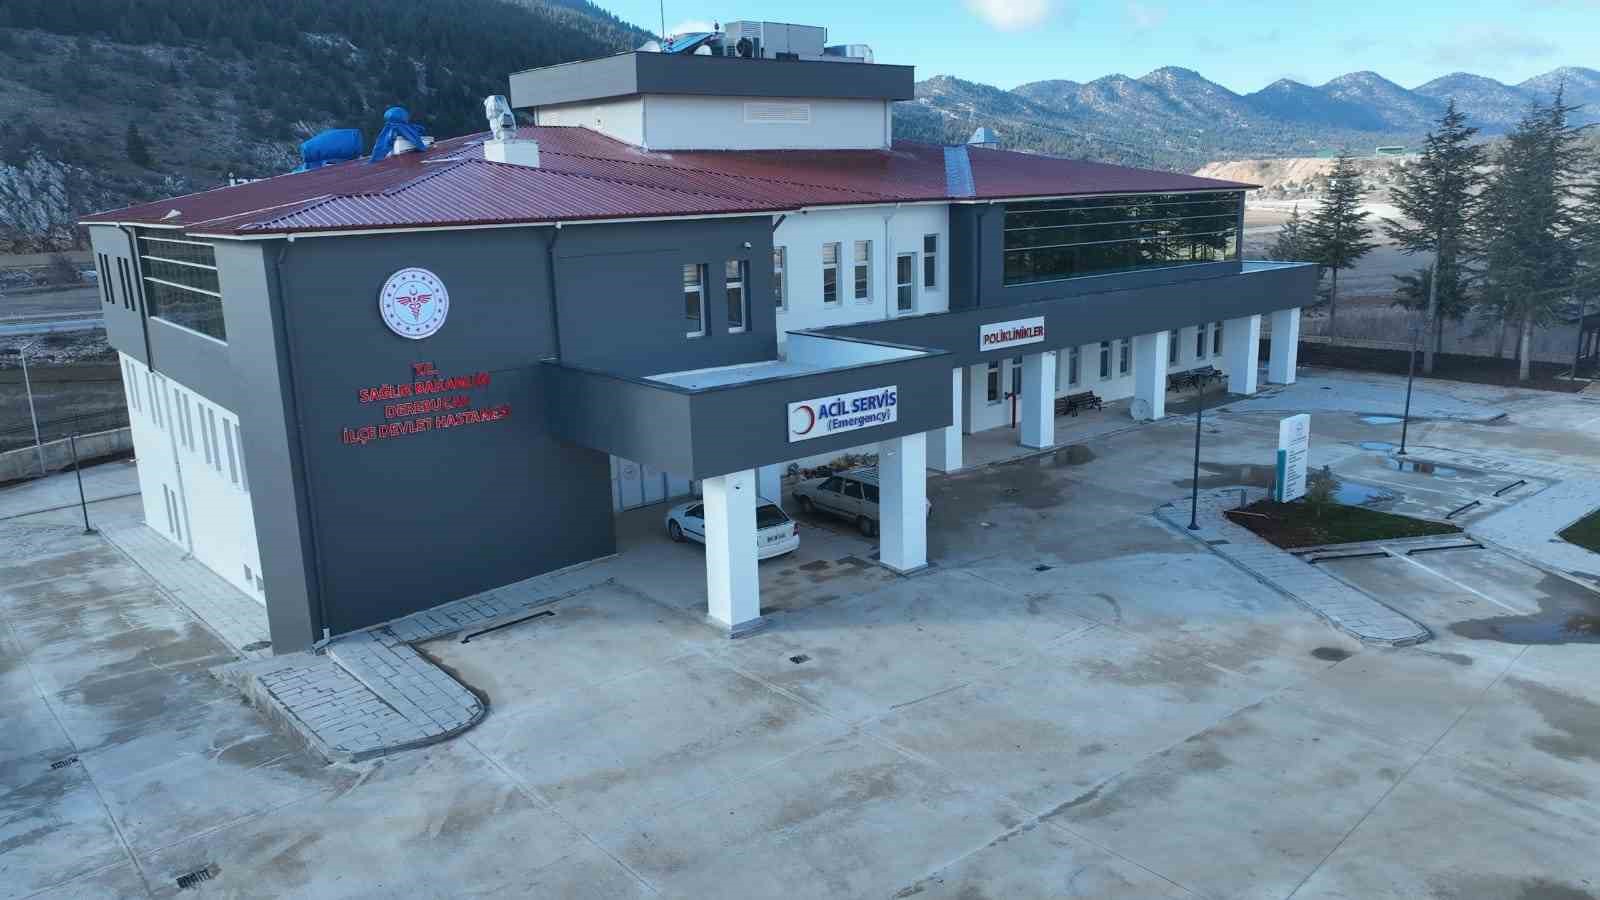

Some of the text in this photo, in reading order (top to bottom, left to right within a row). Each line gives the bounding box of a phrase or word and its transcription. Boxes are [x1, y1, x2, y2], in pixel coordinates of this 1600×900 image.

[983, 326, 1044, 345] POLİKLİNİKLER
[818, 389, 897, 419] ACİL SERVİS
[343, 426, 376, 445] İLÇE
[378, 417, 432, 438] DEVLET
